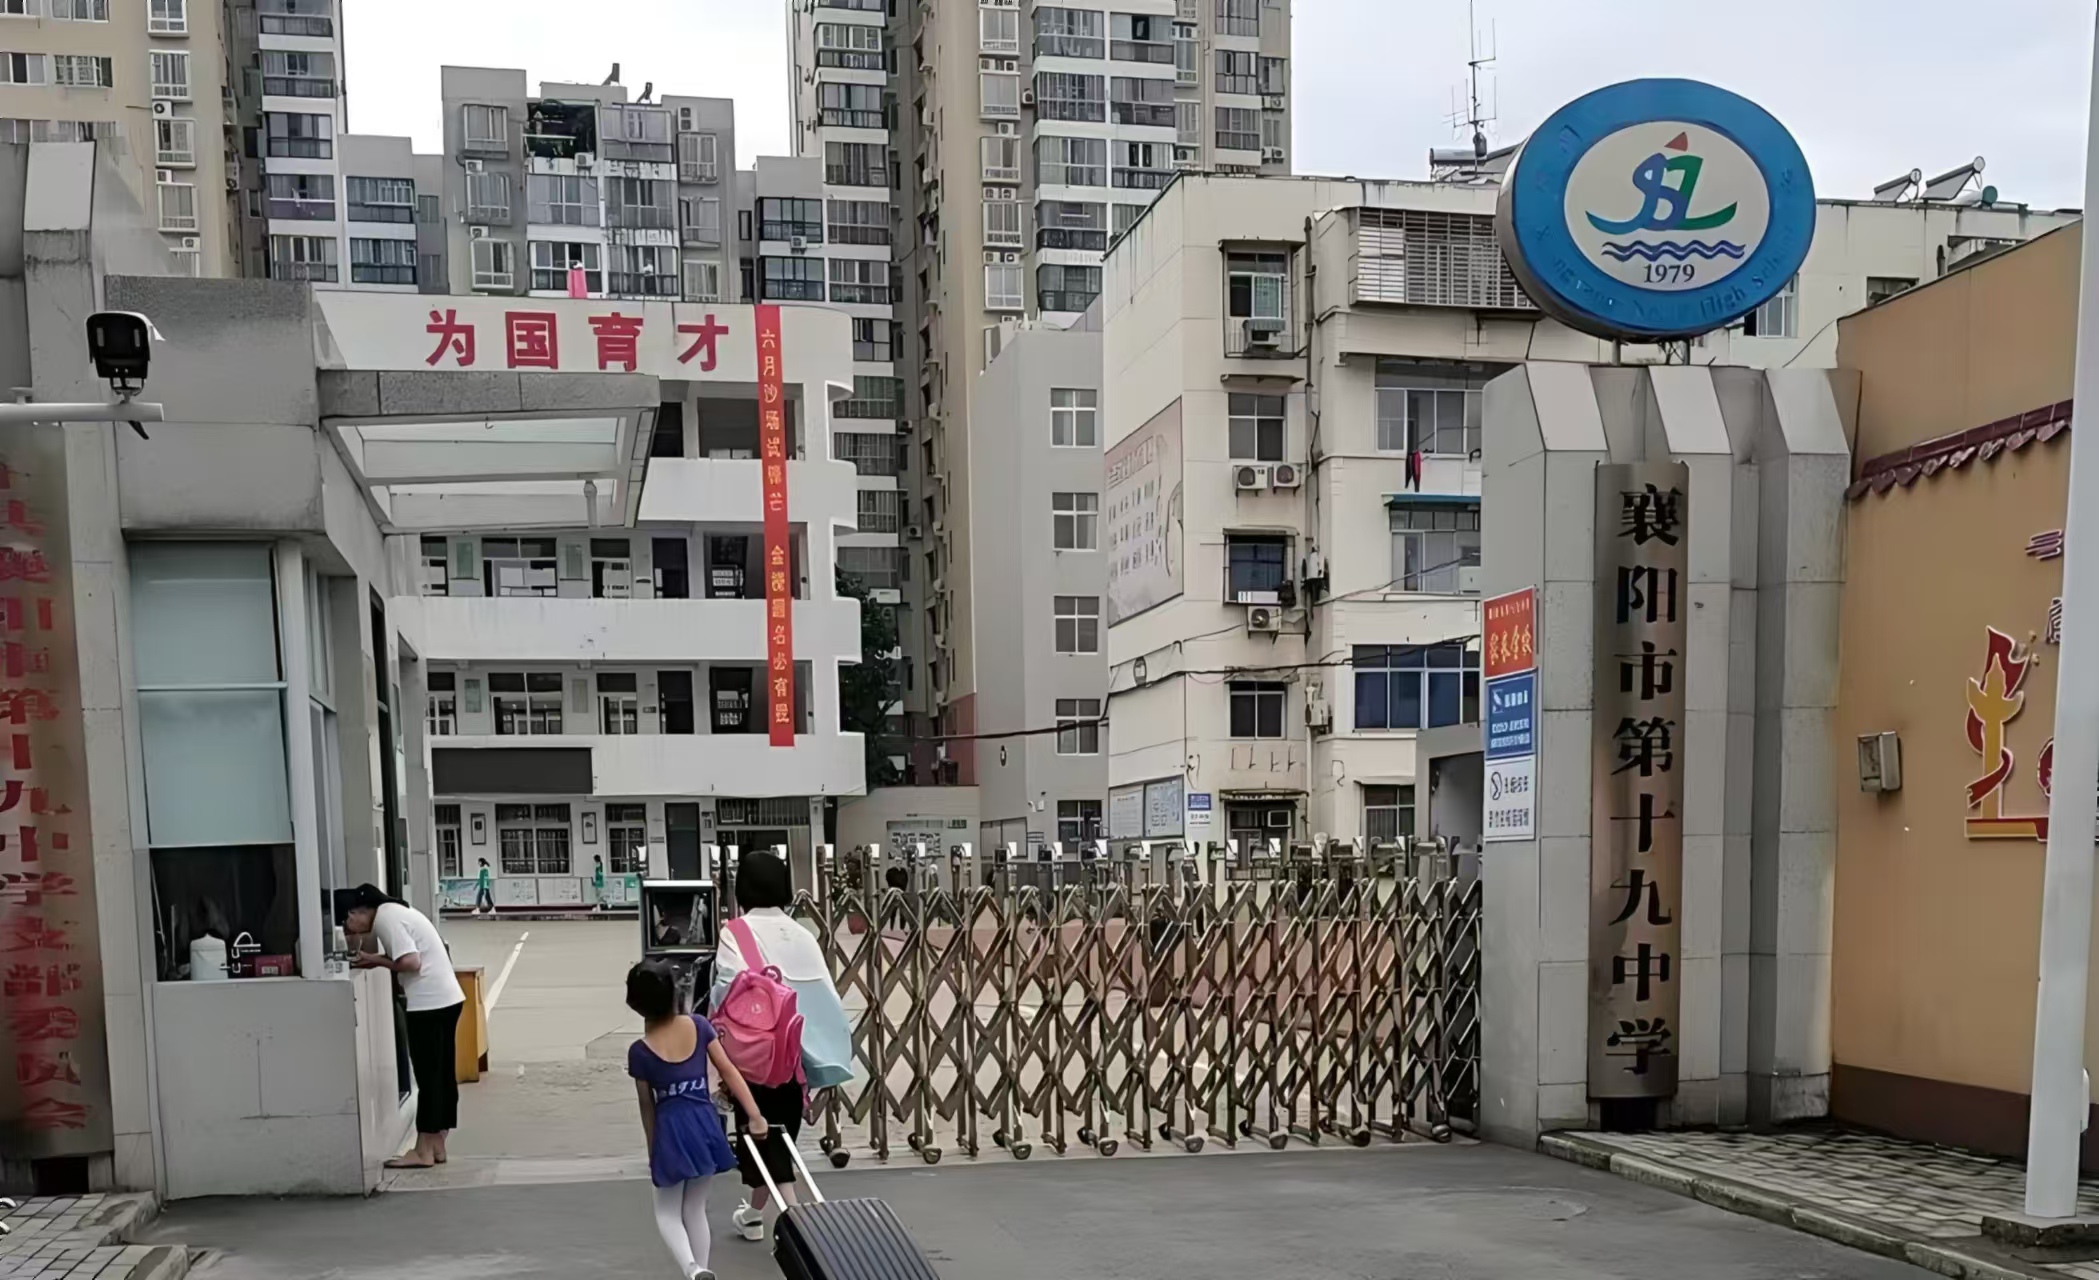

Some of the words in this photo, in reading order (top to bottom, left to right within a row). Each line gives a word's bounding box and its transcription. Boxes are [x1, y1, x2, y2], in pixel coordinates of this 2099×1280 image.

[1643, 262, 1696, 285] 1979
[426, 309, 729, 372] 为国育才
[1606, 482, 1684, 1075] 襄阳市第十九中学
